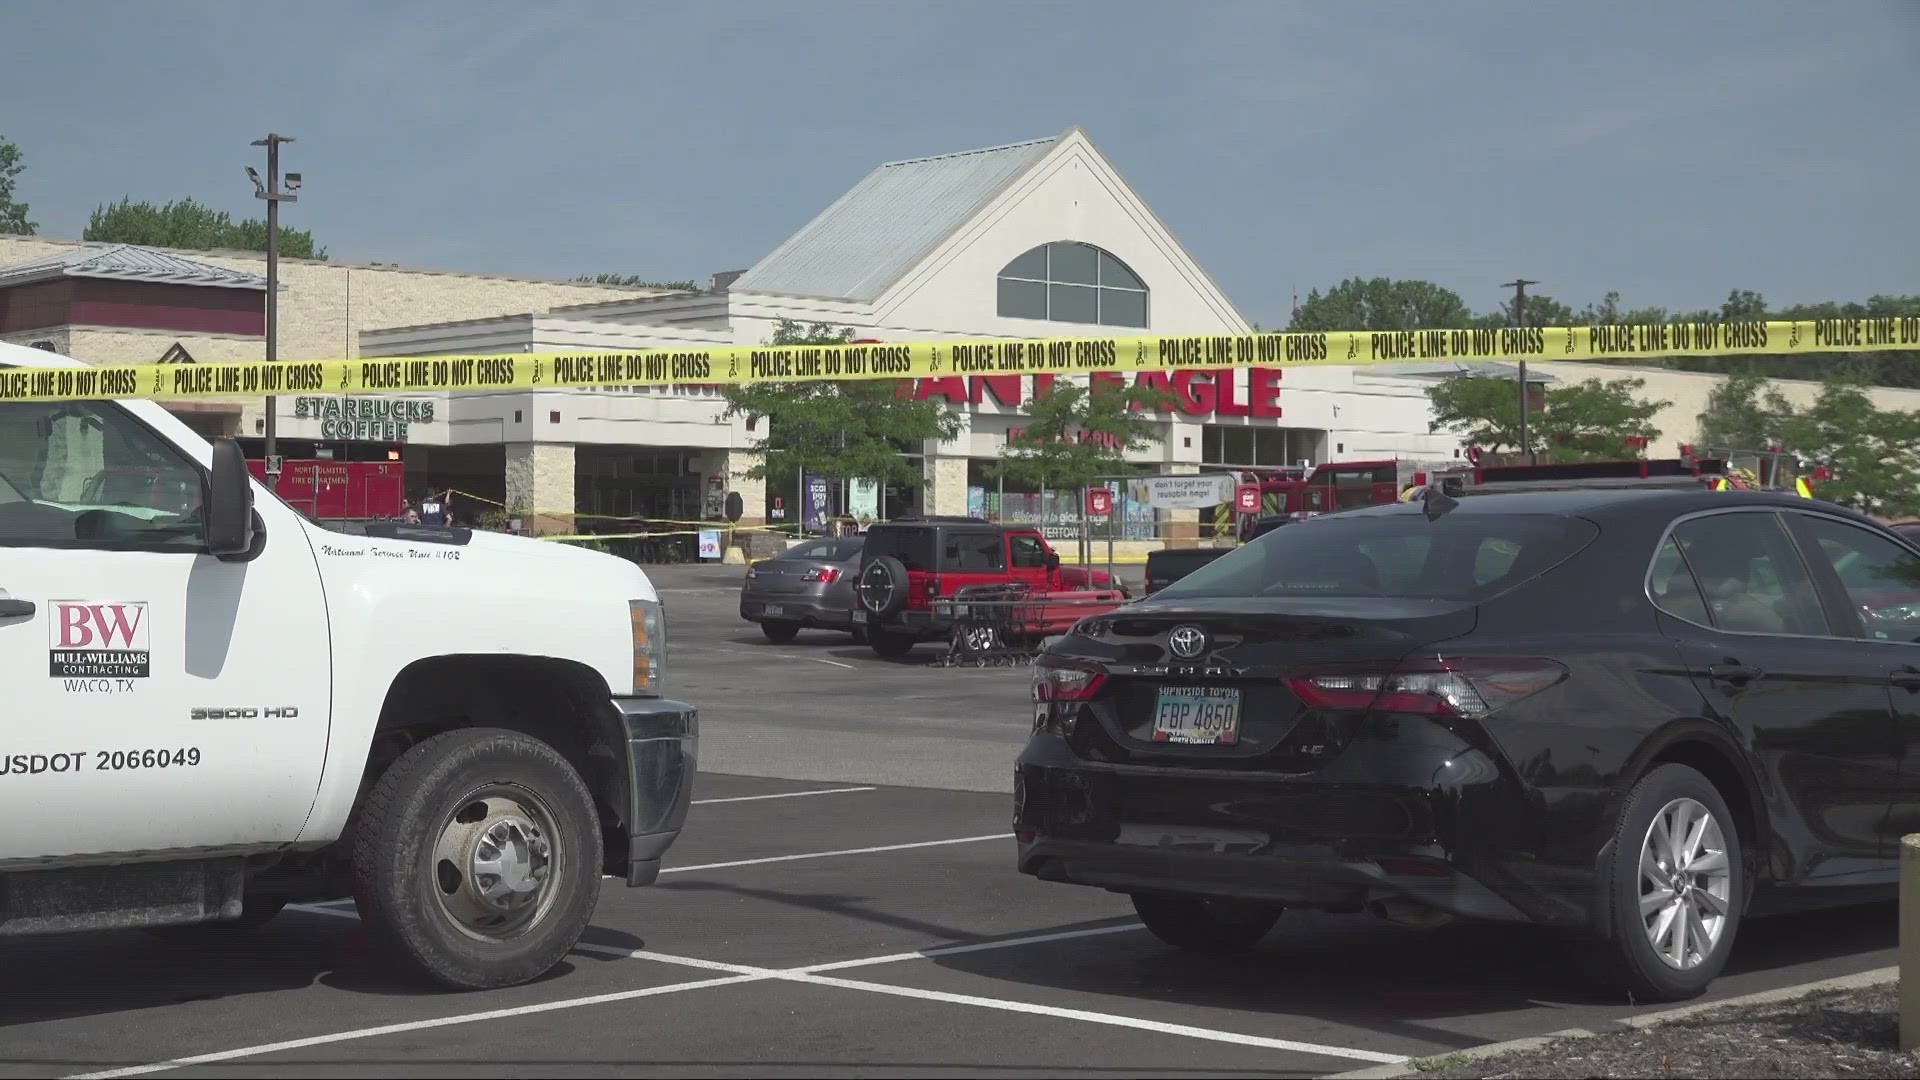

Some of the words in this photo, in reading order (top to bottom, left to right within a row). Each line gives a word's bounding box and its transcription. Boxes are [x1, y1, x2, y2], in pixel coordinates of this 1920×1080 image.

[1372, 332, 1415, 358] POLICE
[1419, 331, 1447, 357] LINE
[1452, 330, 1468, 356] DO
[1473, 329, 1497, 354] NOT
[1501, 328, 1544, 354] CROSS
[1590, 325, 1634, 352] POLICE
[1640, 325, 1668, 352] LINE
[1672, 324, 1690, 350] DO
[1695, 323, 1720, 349] NOT
[1724, 321, 1767, 348] CROSS
[1815, 320, 1860, 347] POLICE
[1866, 319, 1896, 345] LINE
[1900, 318, 1919, 344] DO
[952, 345, 994, 371] POLICE
[998, 344, 1024, 370] LINE
[1028, 343, 1044, 369] DO
[1048, 341, 1072, 368] NOT
[1075, 340, 1115, 366] CROSS
[1159, 338, 1201, 364] POLICE
[1206, 337, 1233, 363] LINE
[1237, 337, 1254, 363] DO
[1257, 336, 1282, 362] NOT
[1285, 334, 1327, 361] CROSS
[362, 361, 400, 389] POLICE
[404, 360, 429, 388] LINE
[432, 360, 448, 387] DO
[452, 359, 473, 387] NOT
[477, 358, 514, 385] CROSS
[554, 357, 594, 383] POLICE
[600, 355, 624, 382] LINE
[627, 354, 642, 380] DO
[645, 353, 668, 380] NOT
[672, 352, 710, 379] CROSS
[751, 351, 791, 377] POLICE
[796, 350, 821, 376] LINE
[825, 349, 841, 375] DO
[845, 348, 867, 374] NOT
[871, 347, 911, 373] CROSS
[0, 373, 27, 398] OLICE
[31, 372, 54, 397] LINE
[58, 370, 72, 396] DO
[76, 369, 96, 395] NOT
[100, 368, 137, 393] CROSS
[174, 367, 212, 395] POLICE
[215, 367, 239, 394] LINE
[244, 366, 258, 393] DO
[262, 364, 283, 391] NOT
[287, 363, 323, 391] CROSS
[295, 398, 435, 423] STARBUCKS
[321, 418, 409, 441] COFFEE
[291, 476, 306, 485] FIRE
[306, 476, 349, 486] DARTMENT
[378, 465, 388, 474] 51
[1157, 489, 1188, 499] reusable
[1174, 479, 1196, 491] forget
[321, 545, 365, 557] National
[55, 604, 144, 649] BW
[62, 664, 140, 675] CONTRACTING
[117, 679, 135, 693] TX
[1158, 685, 1206, 697] SUNNYSIDE
[1209, 687, 1240, 699] TOYOTA
[263, 706, 299, 720] HD
[1159, 702, 1191, 730] FBP
[1193, 703, 1235, 731] 4850
[1169, 735, 1189, 744] NORTH
[96, 746, 202, 771] 2066049
